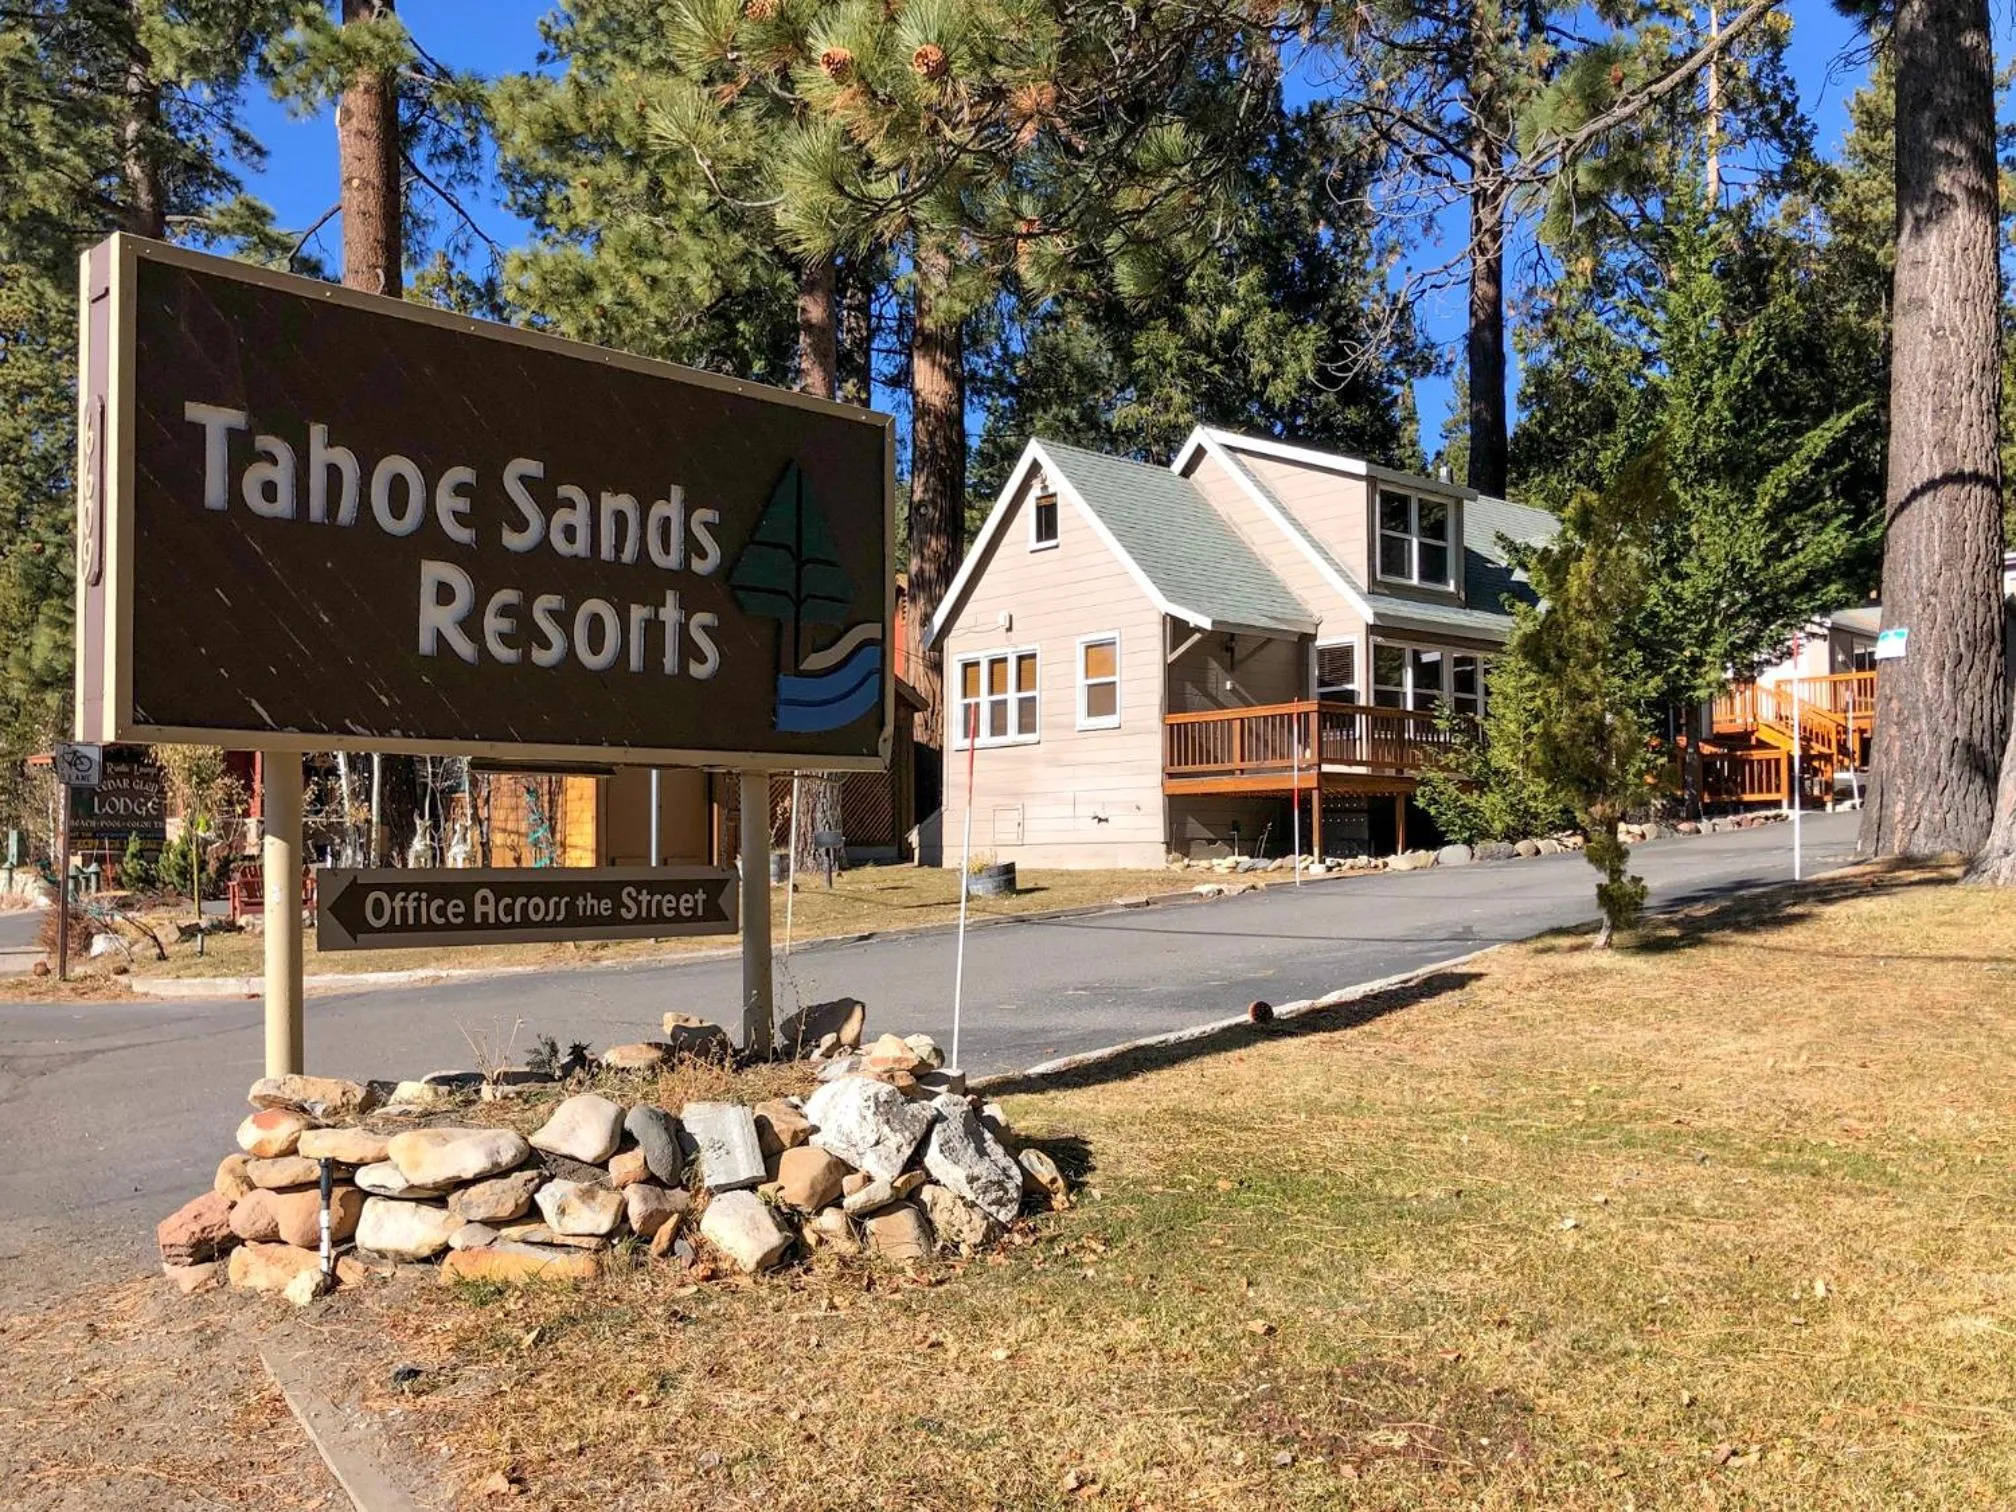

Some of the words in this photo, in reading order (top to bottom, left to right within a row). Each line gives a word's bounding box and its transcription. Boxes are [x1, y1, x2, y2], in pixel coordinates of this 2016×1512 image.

[184, 401, 477, 546] Tahoe
[502, 457, 721, 575] Sands
[418, 558, 720, 680] Resorts
[93, 795, 160, 817] LODGE
[365, 889, 465, 928] Office
[474, 888, 570, 924] Across
[576, 892, 612, 918] the
[620, 886, 707, 919] Street
